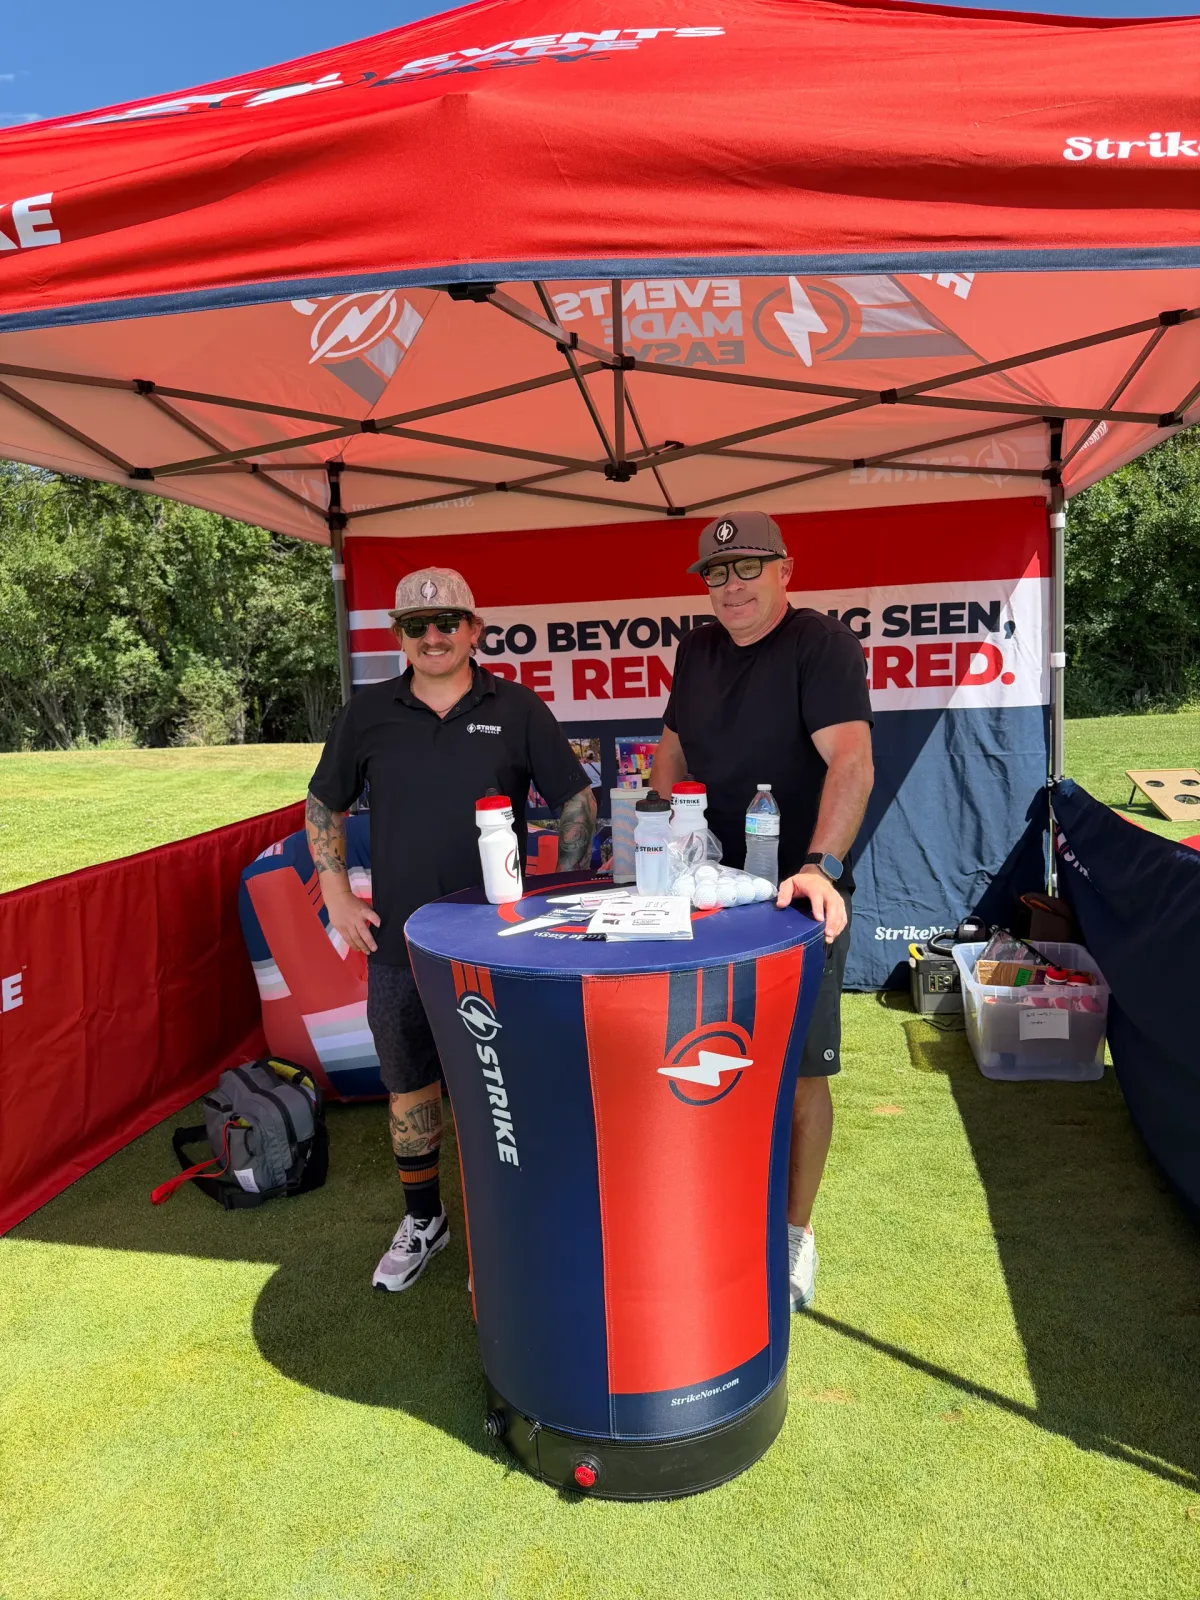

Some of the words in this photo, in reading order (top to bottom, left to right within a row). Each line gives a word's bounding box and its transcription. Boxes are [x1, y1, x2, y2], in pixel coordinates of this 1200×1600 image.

[385, 40, 643, 79] MADE
[402, 27, 726, 70] EVENTS
[1062, 131, 1200, 161] Strik
[480, 623, 537, 656] GO
[882, 600, 1016, 640] SEEN,
[476, 1043, 520, 1167] STRIKE
[670, 1378, 740, 1406] StrikeNow.com
